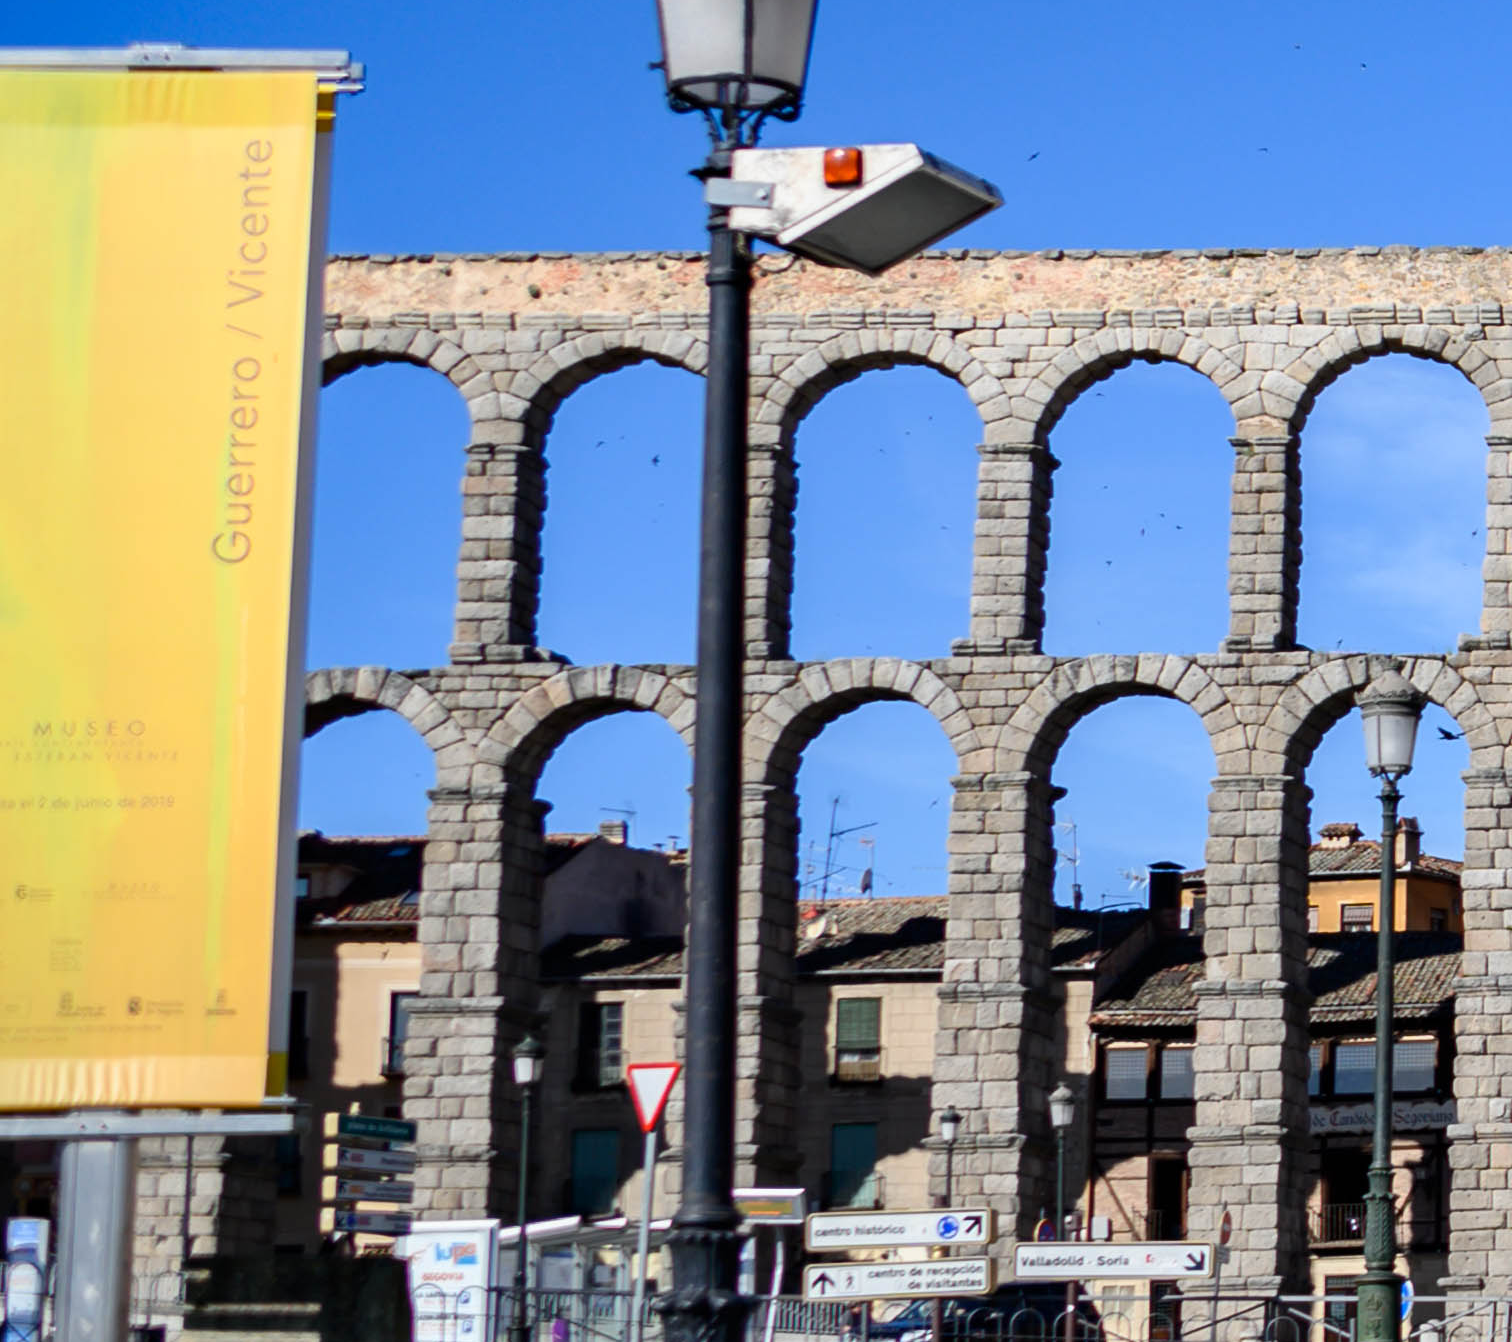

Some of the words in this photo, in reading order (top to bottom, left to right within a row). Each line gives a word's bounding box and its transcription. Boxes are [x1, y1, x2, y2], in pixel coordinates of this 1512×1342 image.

[226, 138, 273, 309] Vicente
[226, 324, 263, 340] /
[211, 356, 262, 564] Guerrero
[33, 720, 146, 737] MUSEO
[814, 1227, 851, 1237] centro
[853, 1225, 906, 1236] histórico
[1020, 1255, 1084, 1267] Valladolid
[1096, 1254, 1130, 1266] Soria
[867, 1269, 905, 1278] centro
[908, 1267, 922, 1277] de
[926, 1264, 983, 1278] recepción
[908, 1280, 922, 1289] de
[926, 1278, 982, 1289] visitantes
